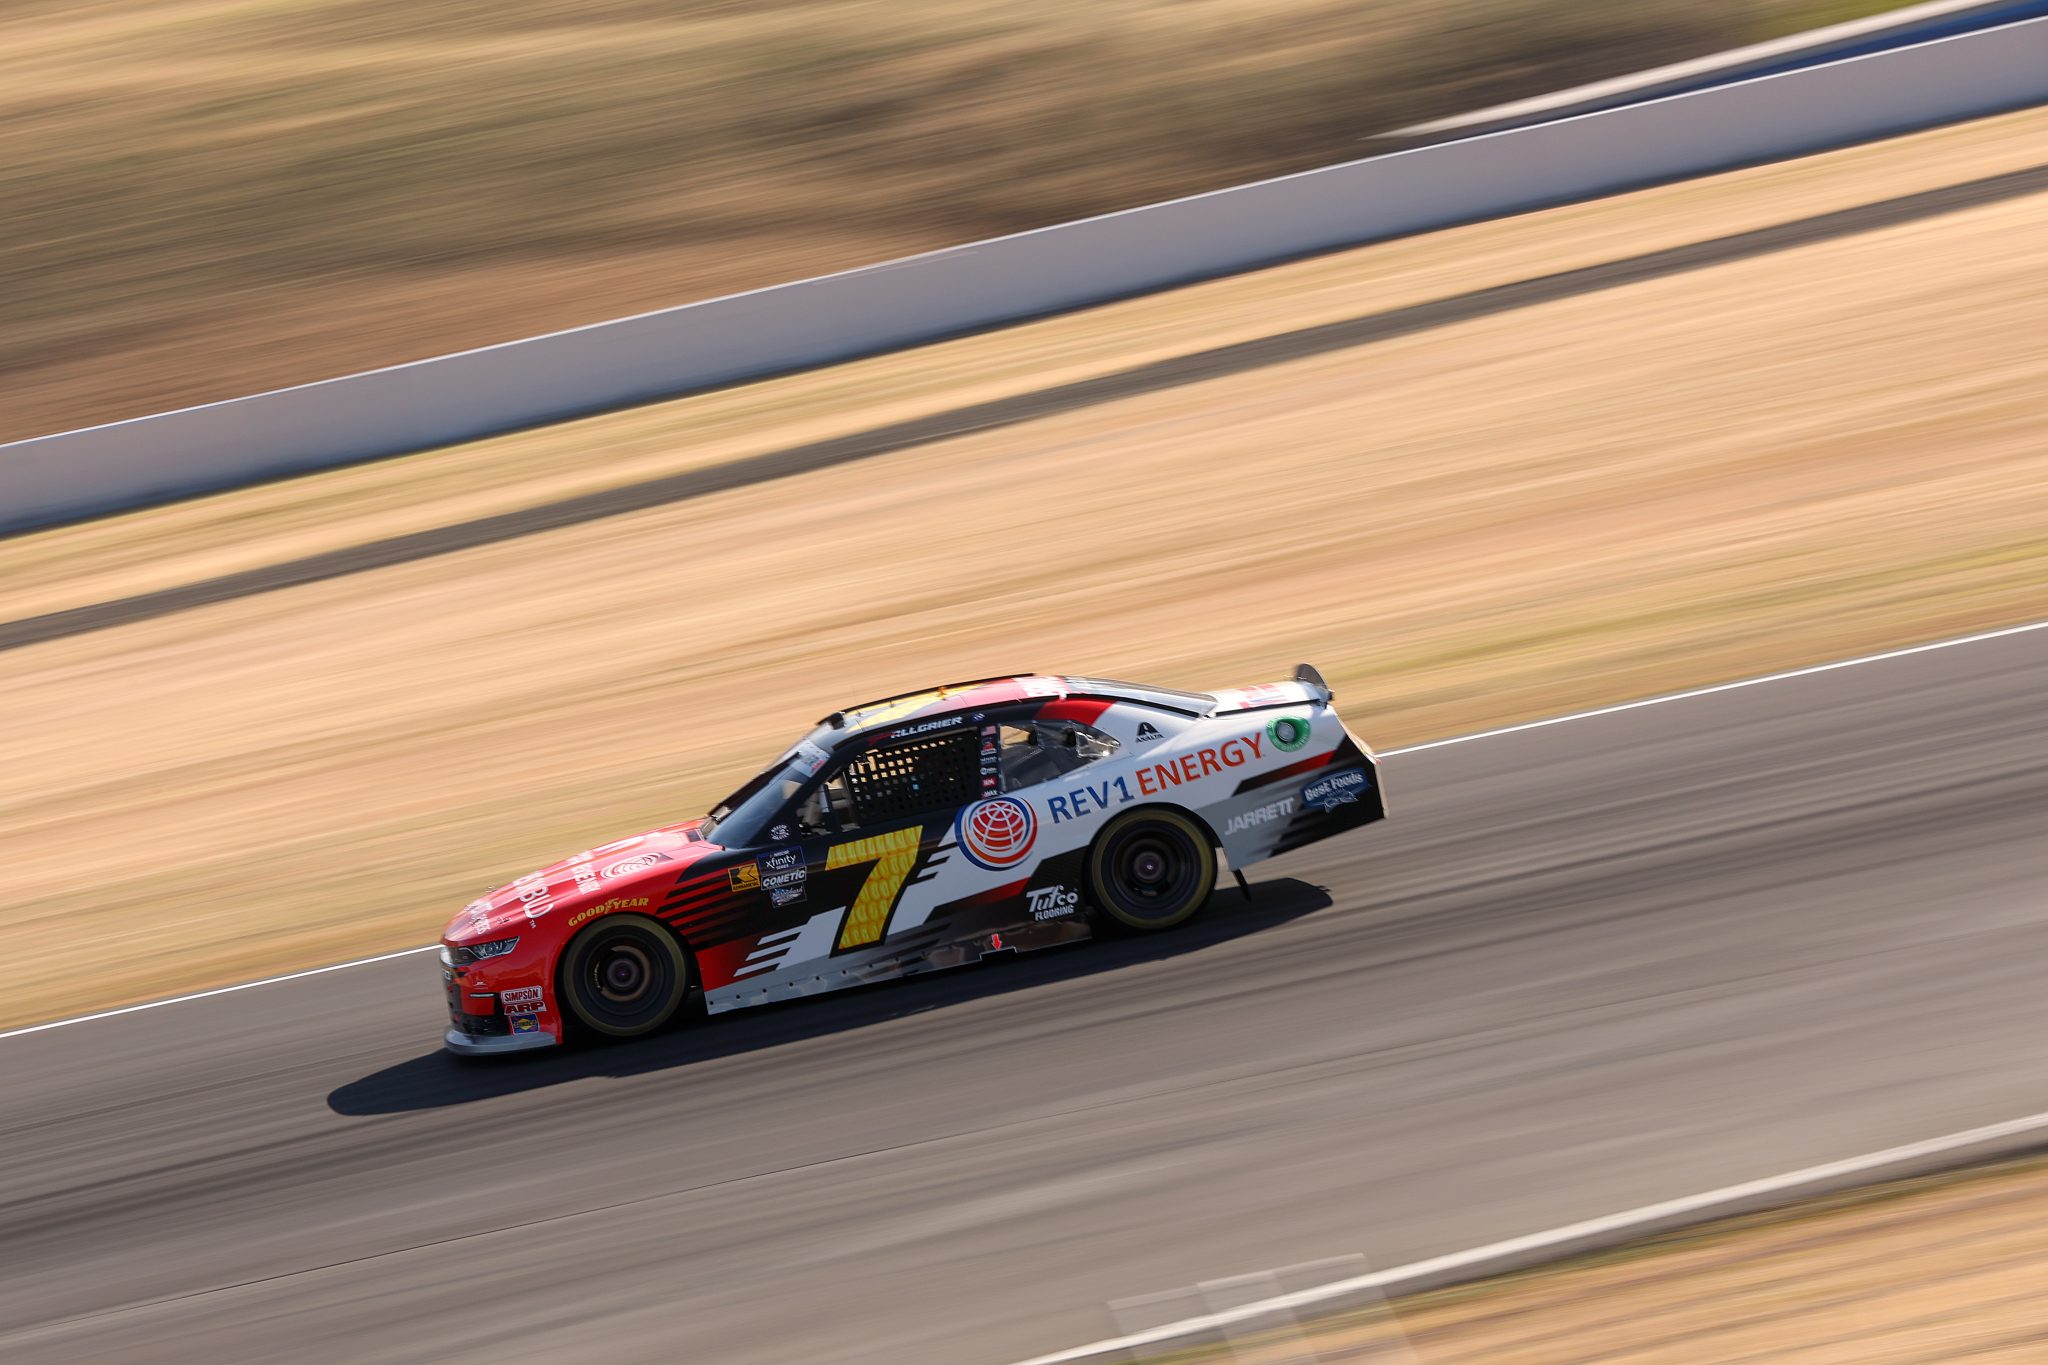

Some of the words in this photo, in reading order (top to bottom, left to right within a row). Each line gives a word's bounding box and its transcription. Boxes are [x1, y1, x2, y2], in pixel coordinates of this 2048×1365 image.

[1047, 776, 1135, 825] REV1
[1135, 732, 1264, 797] ENERGY
[1304, 782, 1332, 801] Best
[1330, 773, 1364, 790] Foods
[1224, 798, 1295, 836] JARRETT
[765, 854, 797, 869] xfinity
[762, 869, 806, 888] COMETIC
[825, 824, 923, 951] 7
[567, 896, 649, 927] GOODYEAR
[1026, 884, 1079, 913] Tufco
[1034, 904, 1075, 921] FLOORING
[504, 988, 539, 1002] SIMPSON
[505, 1001, 544, 1014] ARP
